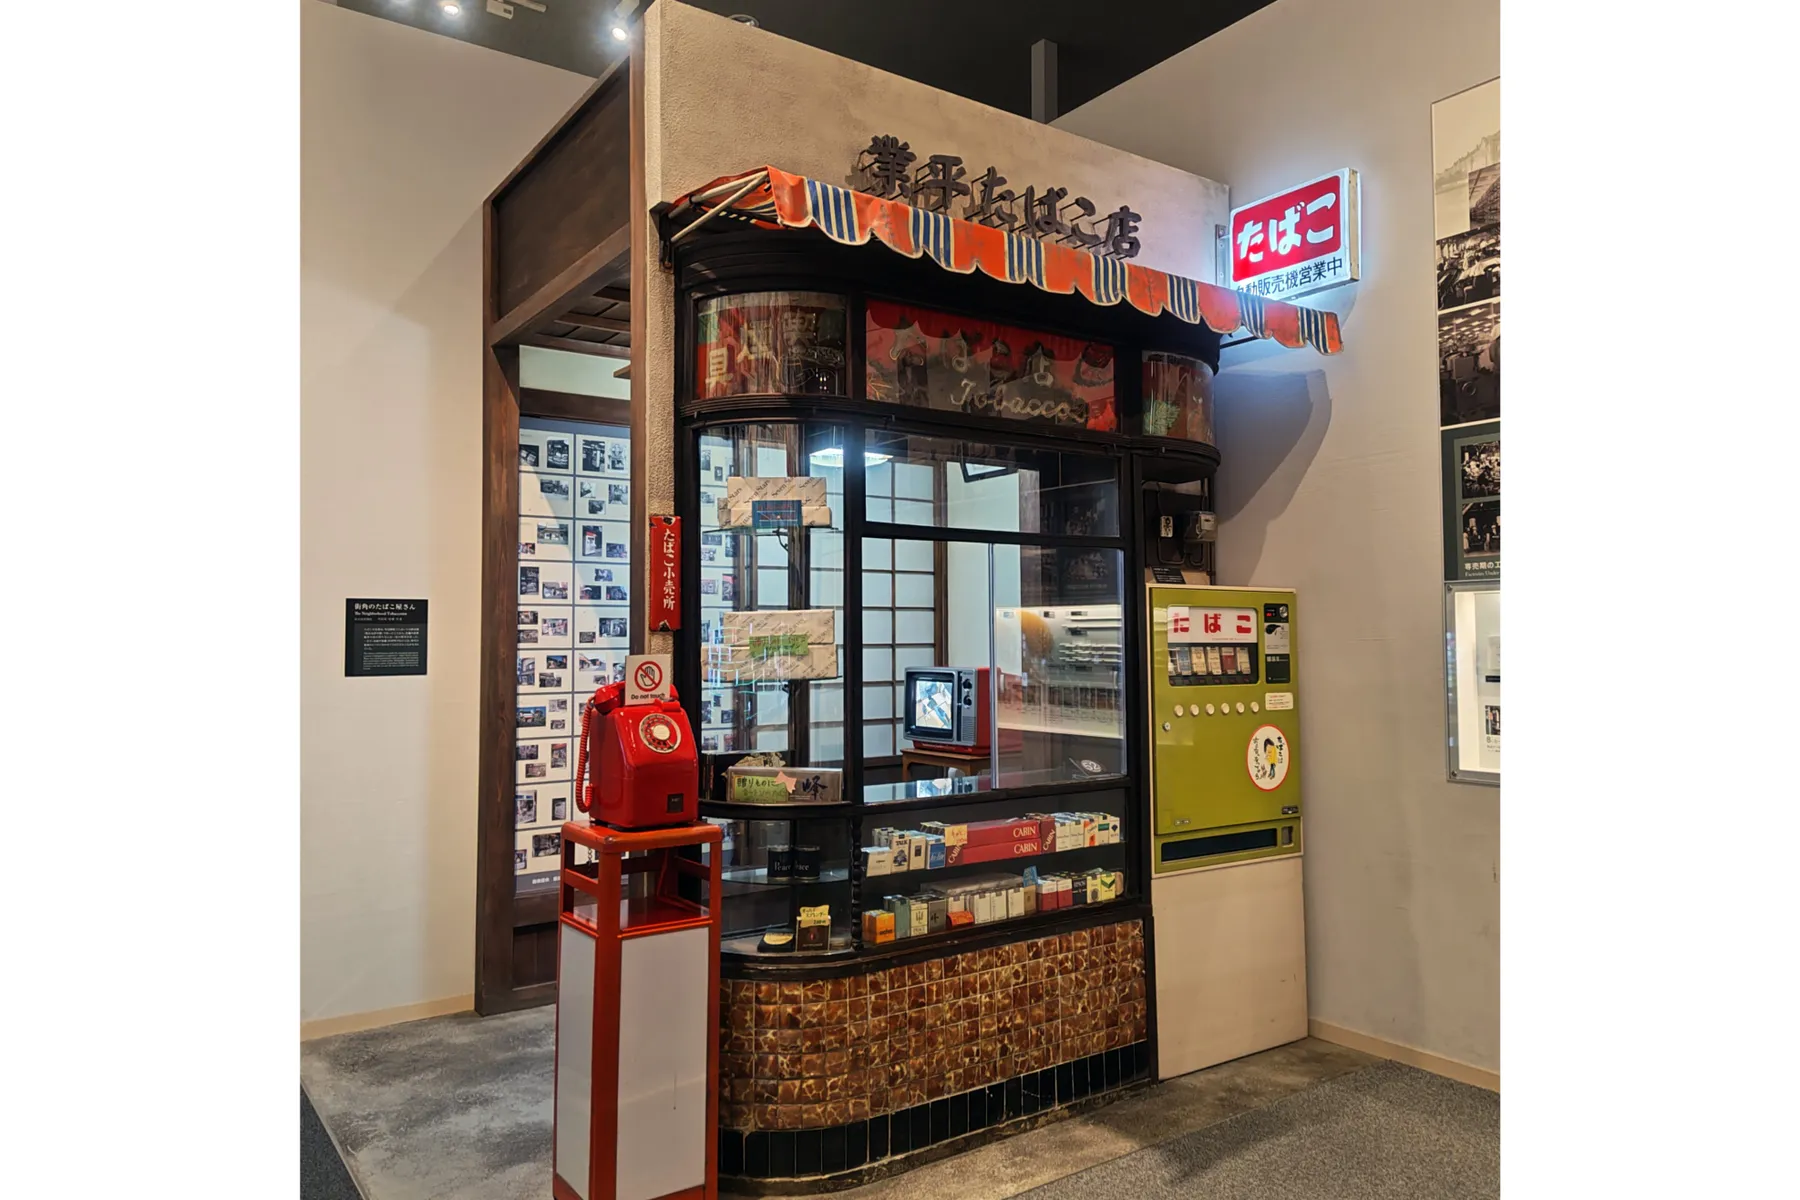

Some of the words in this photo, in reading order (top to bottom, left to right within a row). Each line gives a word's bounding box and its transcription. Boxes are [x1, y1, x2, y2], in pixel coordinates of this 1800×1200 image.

[866, 134, 1143, 259] 業平たばこ店
[1236, 192, 1337, 263] たばこ
[663, 528, 676, 611] たばこ小売所
[1013, 825, 1036, 838] CABIN
[1013, 842, 1038, 854] CABIN
[1042, 829, 1056, 851] CABIN
